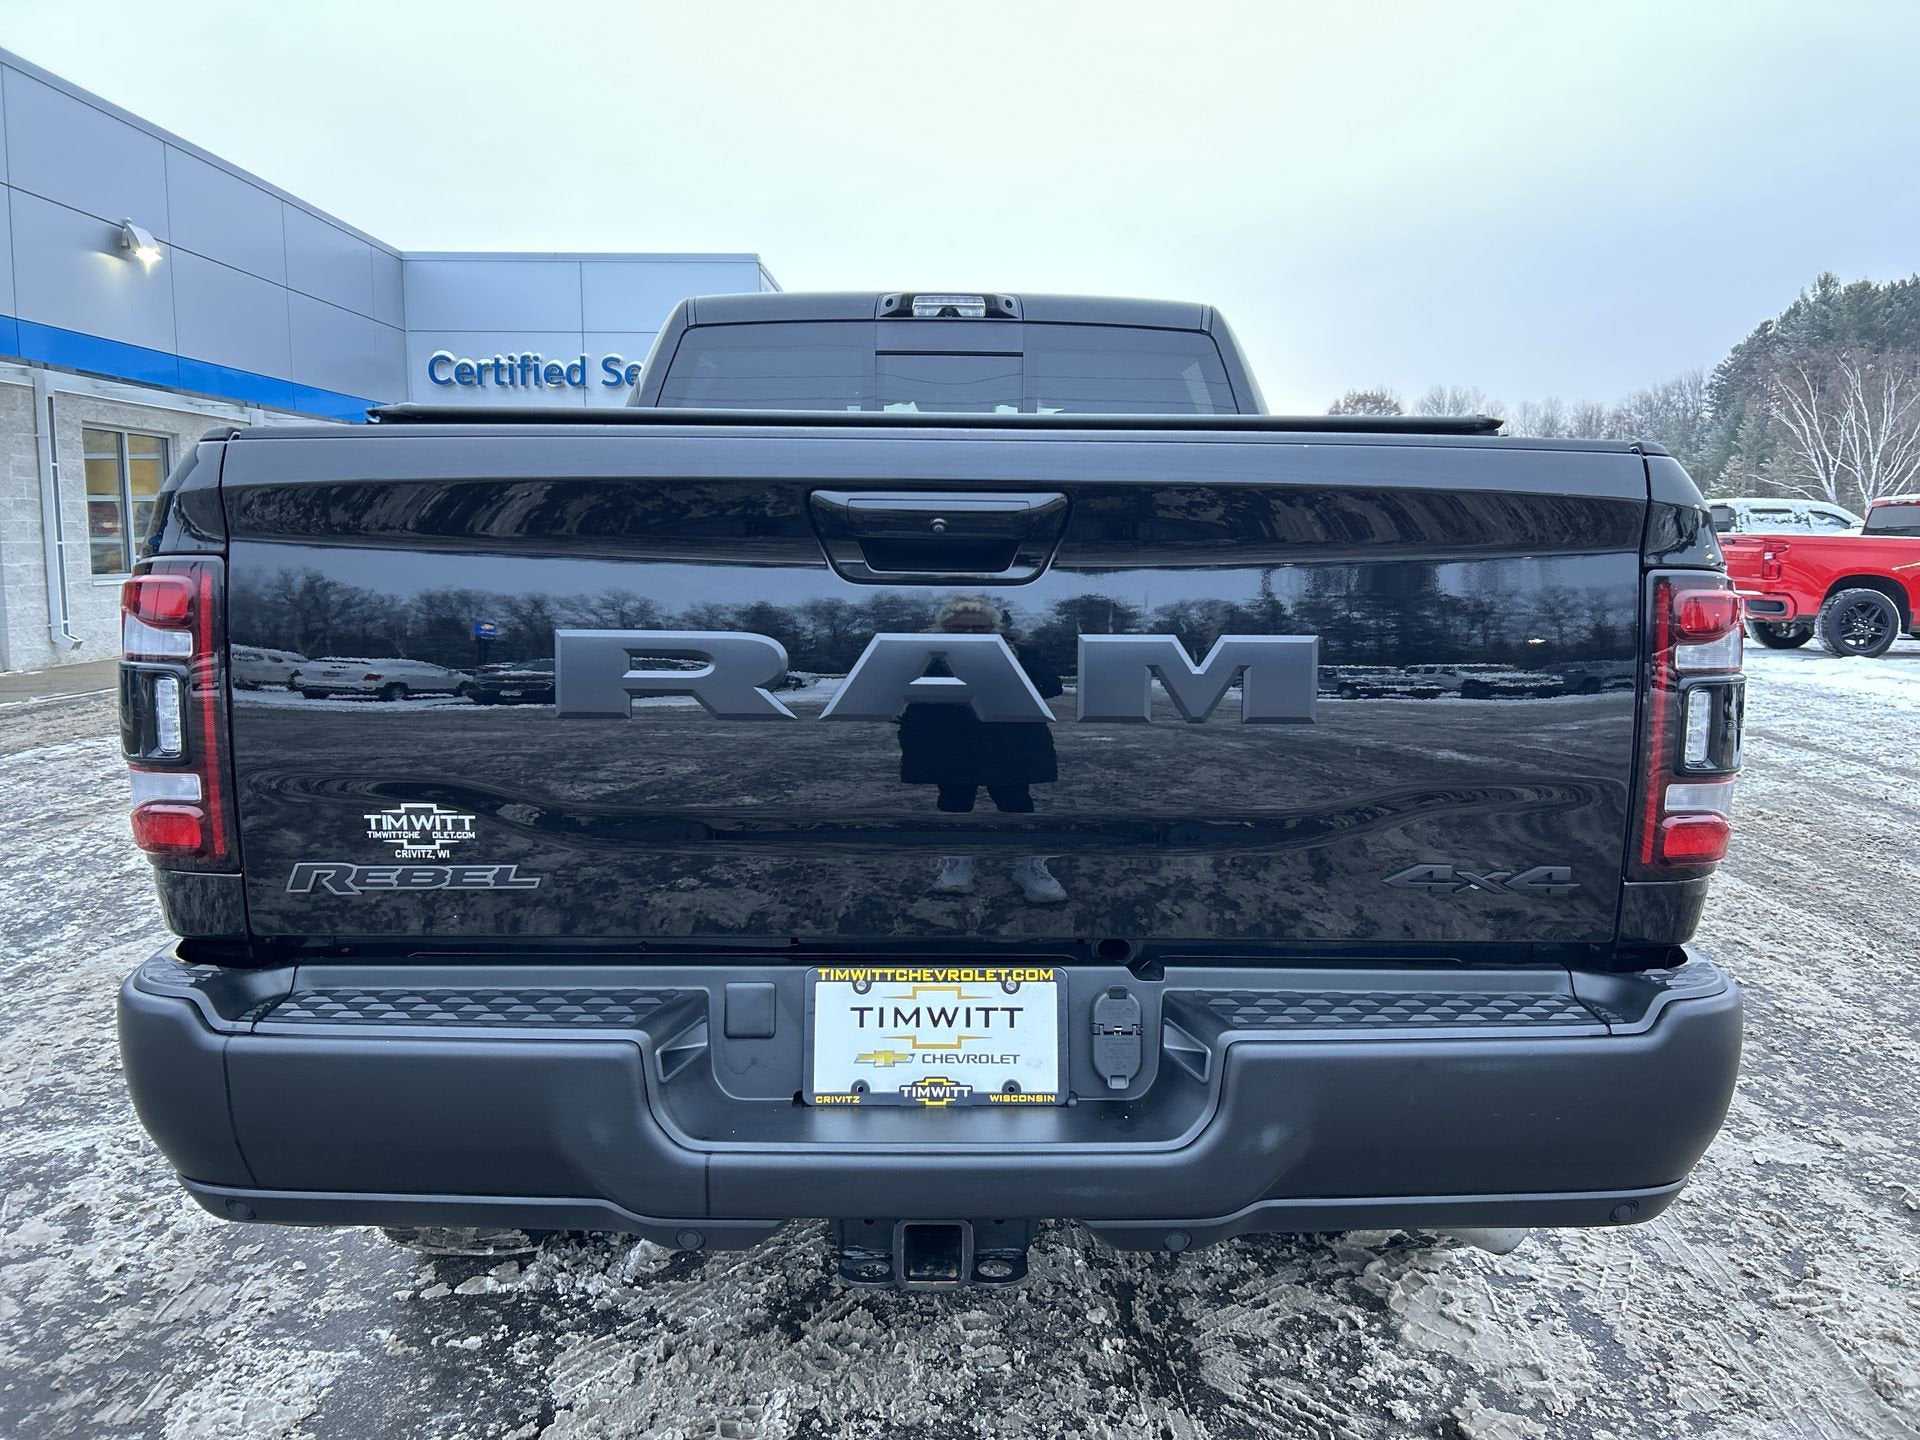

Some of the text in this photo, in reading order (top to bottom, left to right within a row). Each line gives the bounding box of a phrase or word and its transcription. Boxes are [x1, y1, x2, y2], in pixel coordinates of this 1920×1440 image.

[428, 354, 587, 387] Certified
[555, 629, 1319, 723] RAM
[366, 830, 476, 840] TIMWITTCHEOLET.COM
[394, 849, 451, 860] CRIVITZ, WI
[286, 862, 542, 895] REBEL
[817, 968, 1055, 982] TIMWITTCHEVROLET.COM
[850, 1006, 1024, 1029] TIMWITT
[921, 1053, 1021, 1065] CHEVROLET
[900, 1085, 973, 1099] TIMWITT
[989, 1094, 1056, 1103] WISCONSIN
[814, 1095, 861, 1104] CRIVITZ
